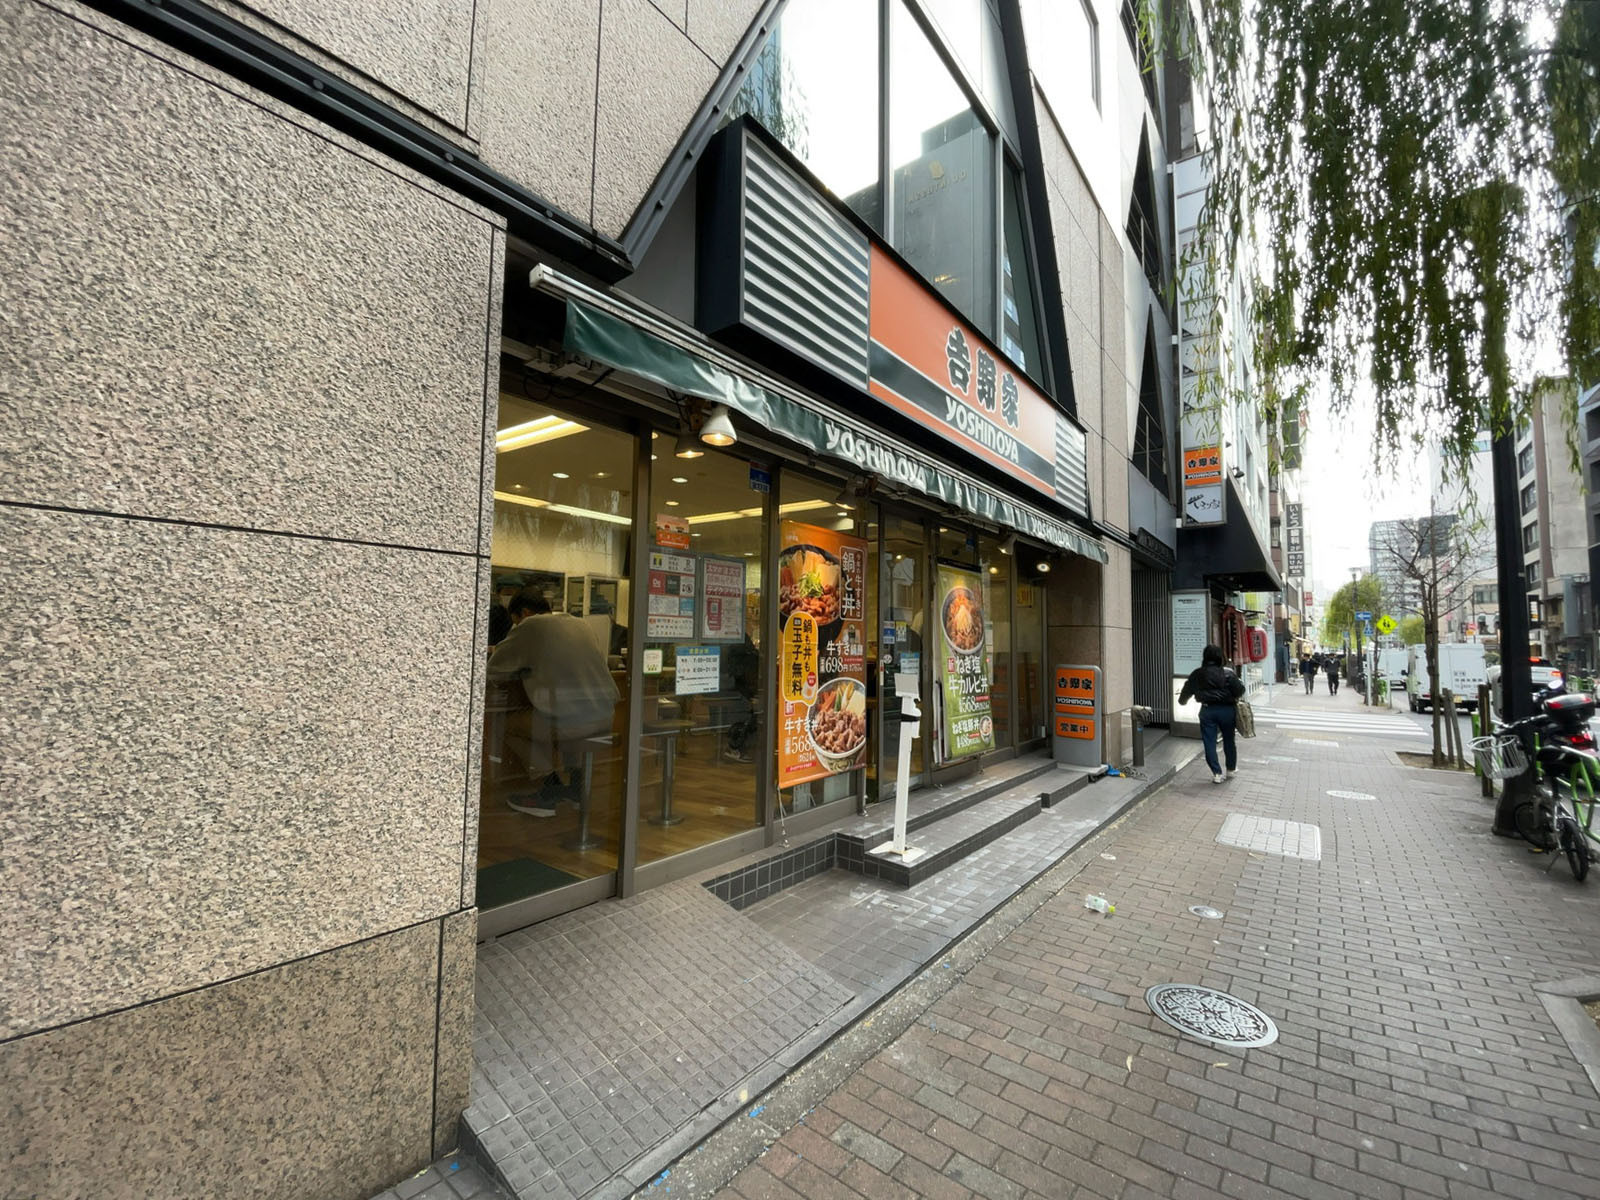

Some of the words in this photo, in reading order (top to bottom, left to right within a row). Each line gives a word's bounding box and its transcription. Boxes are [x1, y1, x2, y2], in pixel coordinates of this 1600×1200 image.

[945, 326, 1020, 431] 吉野家
[945, 395, 1019, 464] YOSHINOYA
[825, 421, 928, 491] YOSHINOYA
[842, 551, 856, 617] 鍋と丼
[948, 674, 988, 697] 牛カルビ丼
[1057, 676, 1093, 691] 吉野家
[1057, 697, 1093, 707] YOSHINOYA
[1060, 722, 1089, 734] 営業中
